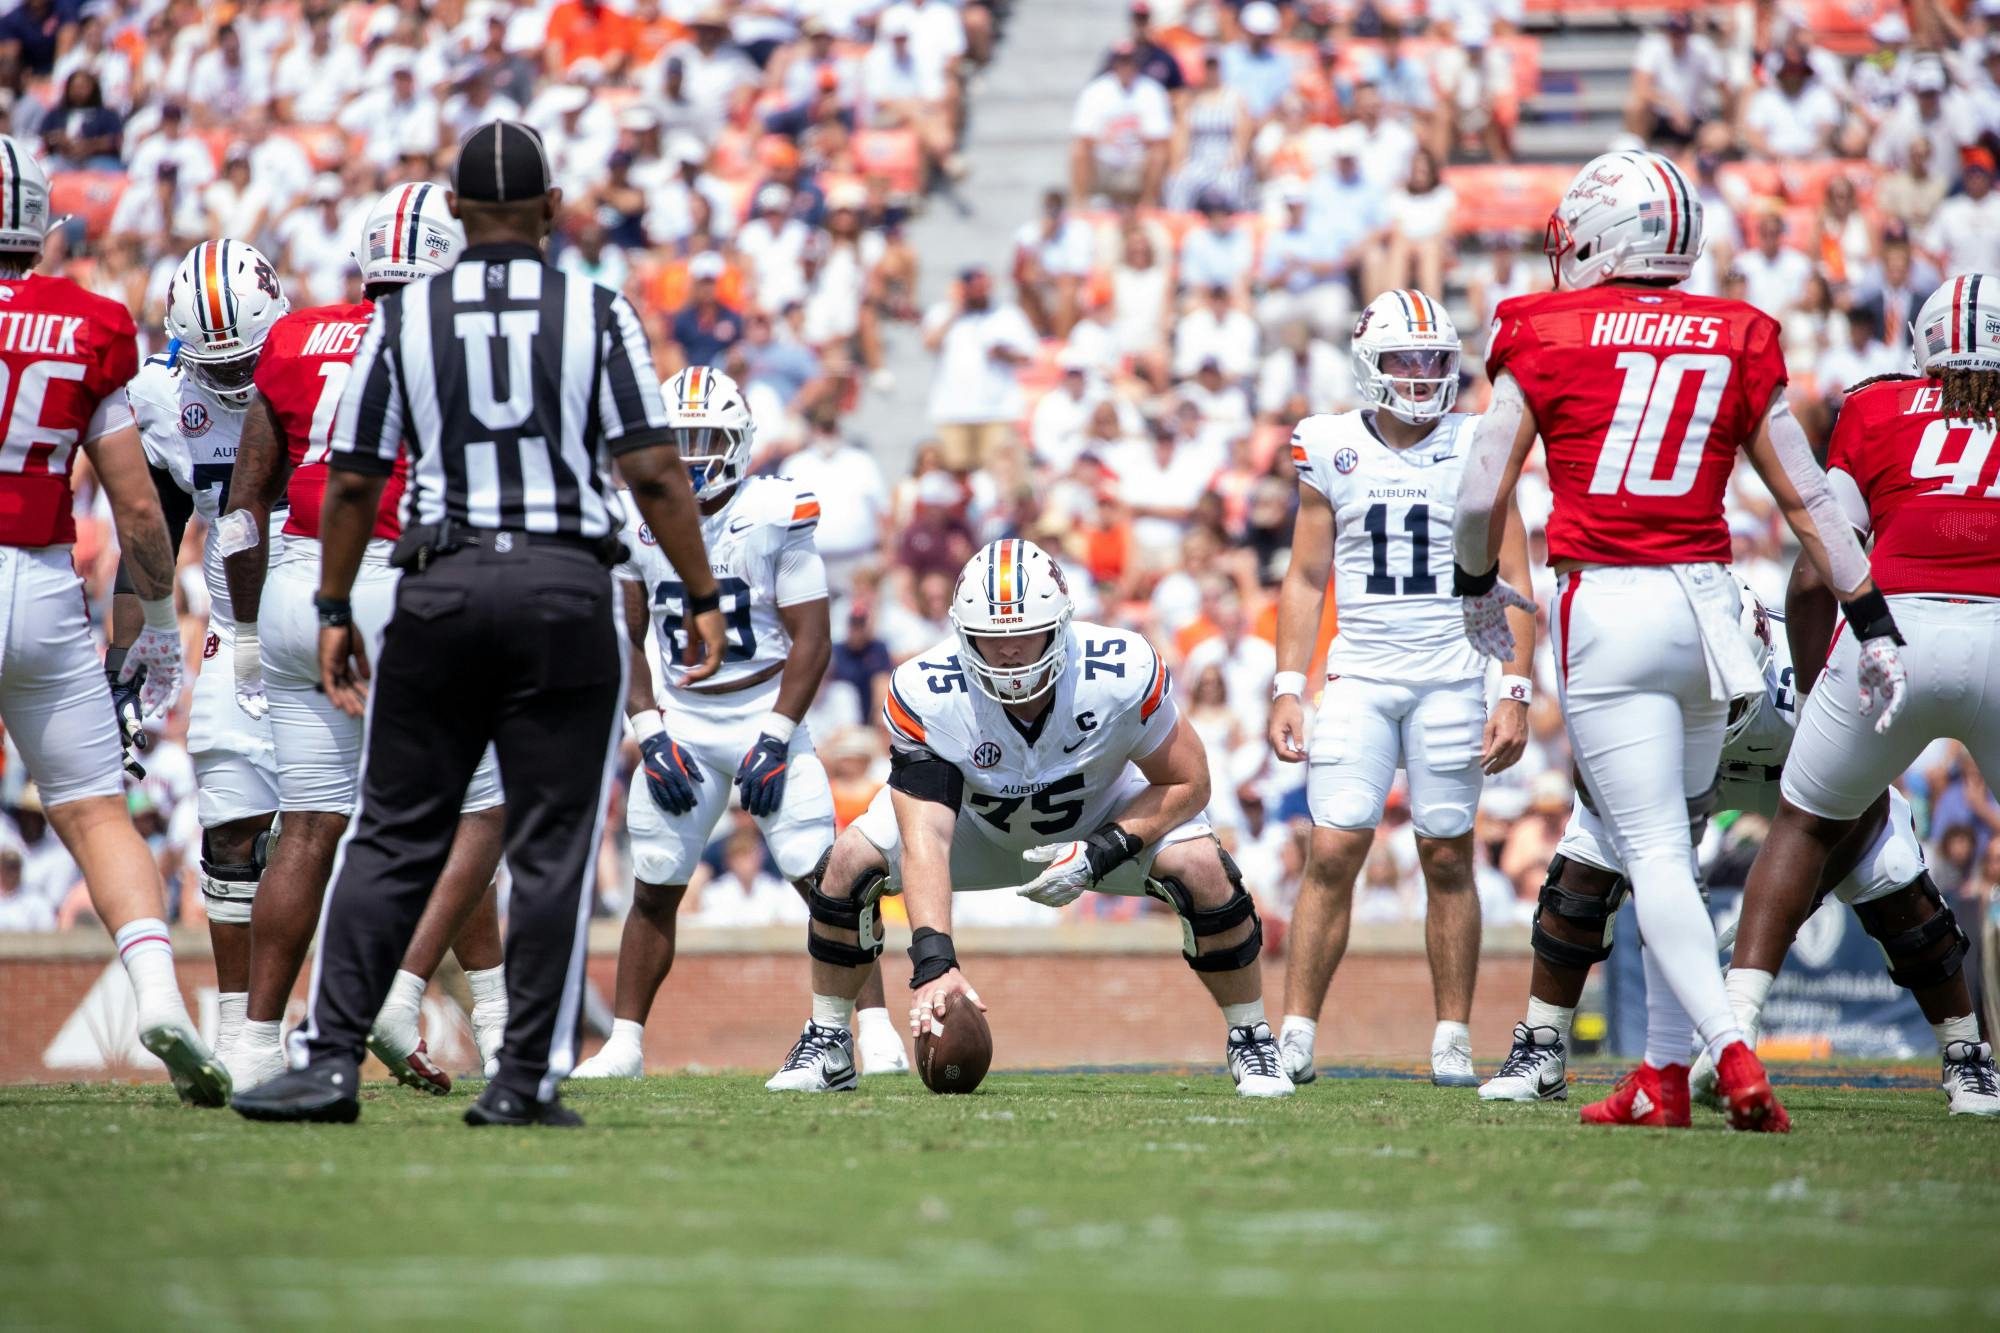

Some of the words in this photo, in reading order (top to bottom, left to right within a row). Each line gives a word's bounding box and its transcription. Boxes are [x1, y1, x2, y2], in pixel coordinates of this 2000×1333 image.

[384, 270, 408, 278] STRONG
[301, 322, 368, 356] MOS
[1590, 312, 1724, 349] HUGHES
[207, 341, 239, 351] TIGERS
[453, 309, 540, 431] U
[1946, 359, 1972, 367] STRONG
[183, 404, 206, 429] SEC
[302, 361, 353, 464] 1
[1587, 352, 1733, 497] 10
[1335, 449, 1357, 473] SEC
[1910, 417, 2000, 498] 9
[1368, 489, 1427, 499] AUBURN
[1364, 503, 1438, 596] 11
[991, 616, 1024, 625] TIGERS
[1085, 638, 1127, 681] 75
[917, 655, 969, 694] 75
[1075, 711, 1098, 732] C
[975, 743, 1001, 767] SEC
[999, 782, 1050, 795] AUBUR
[970, 773, 1085, 836] 75
